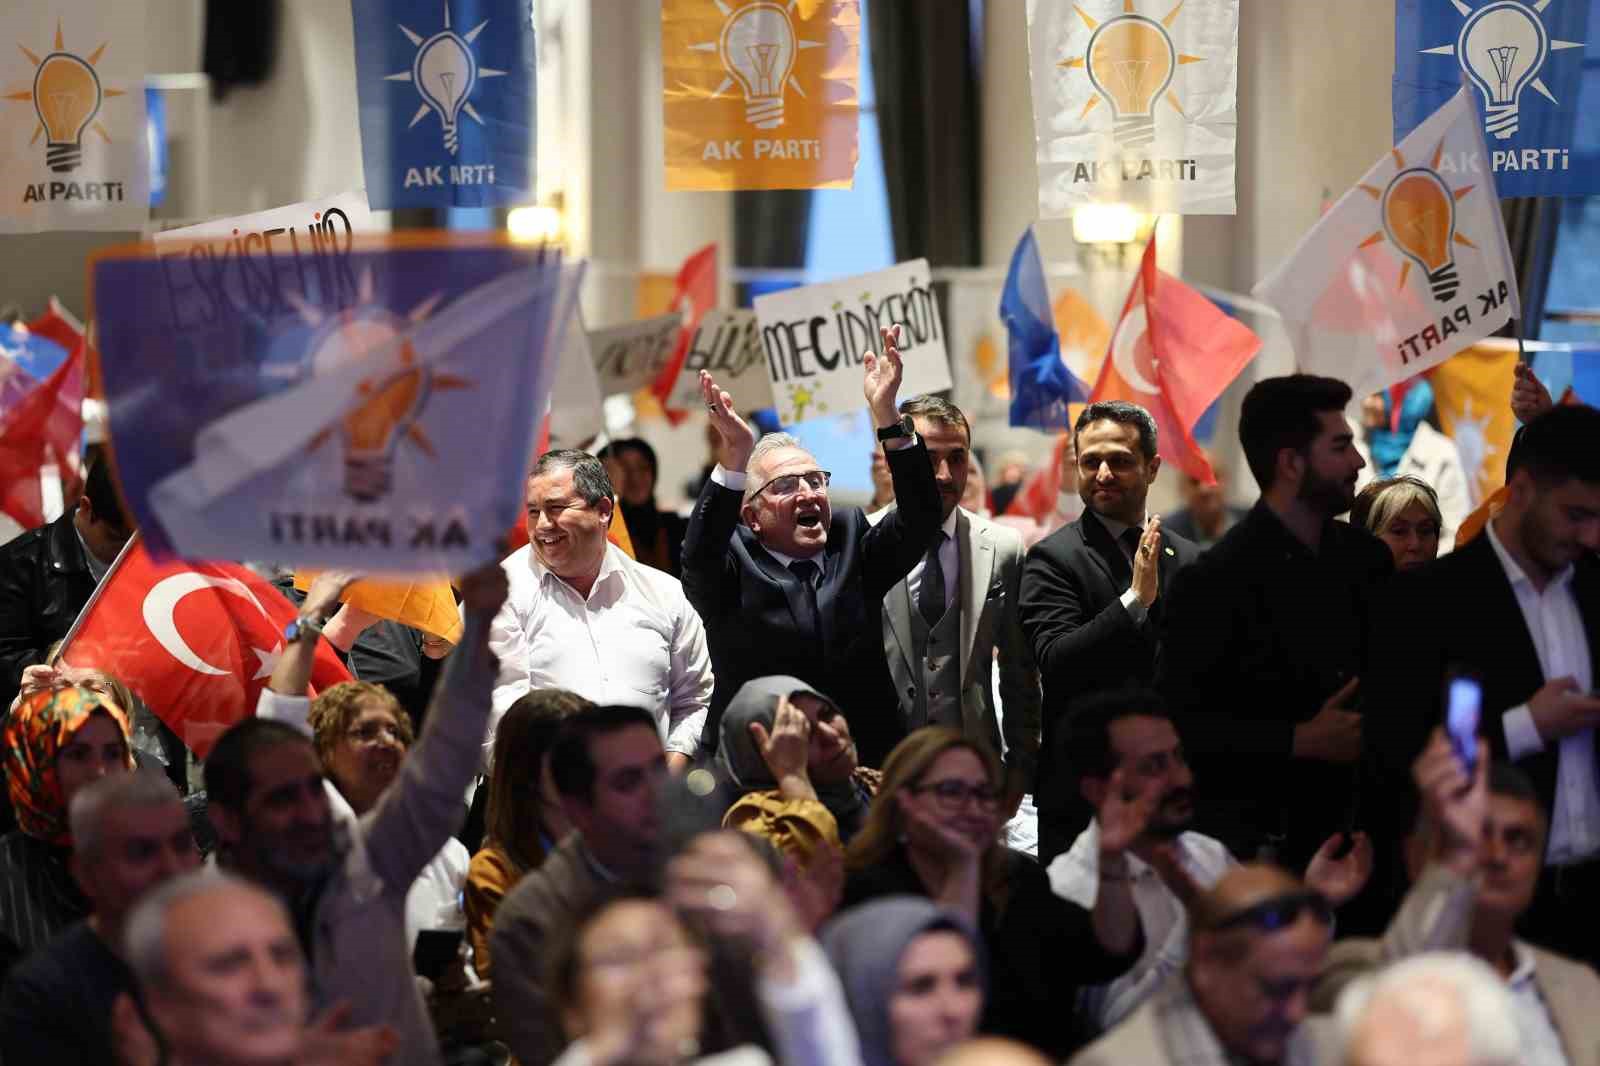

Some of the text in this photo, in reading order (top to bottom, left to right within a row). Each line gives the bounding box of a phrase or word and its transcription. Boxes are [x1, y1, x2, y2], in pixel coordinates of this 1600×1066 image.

[703, 138, 743, 161] AK
[403, 165, 445, 190] AK
[23, 182, 47, 204] AK
